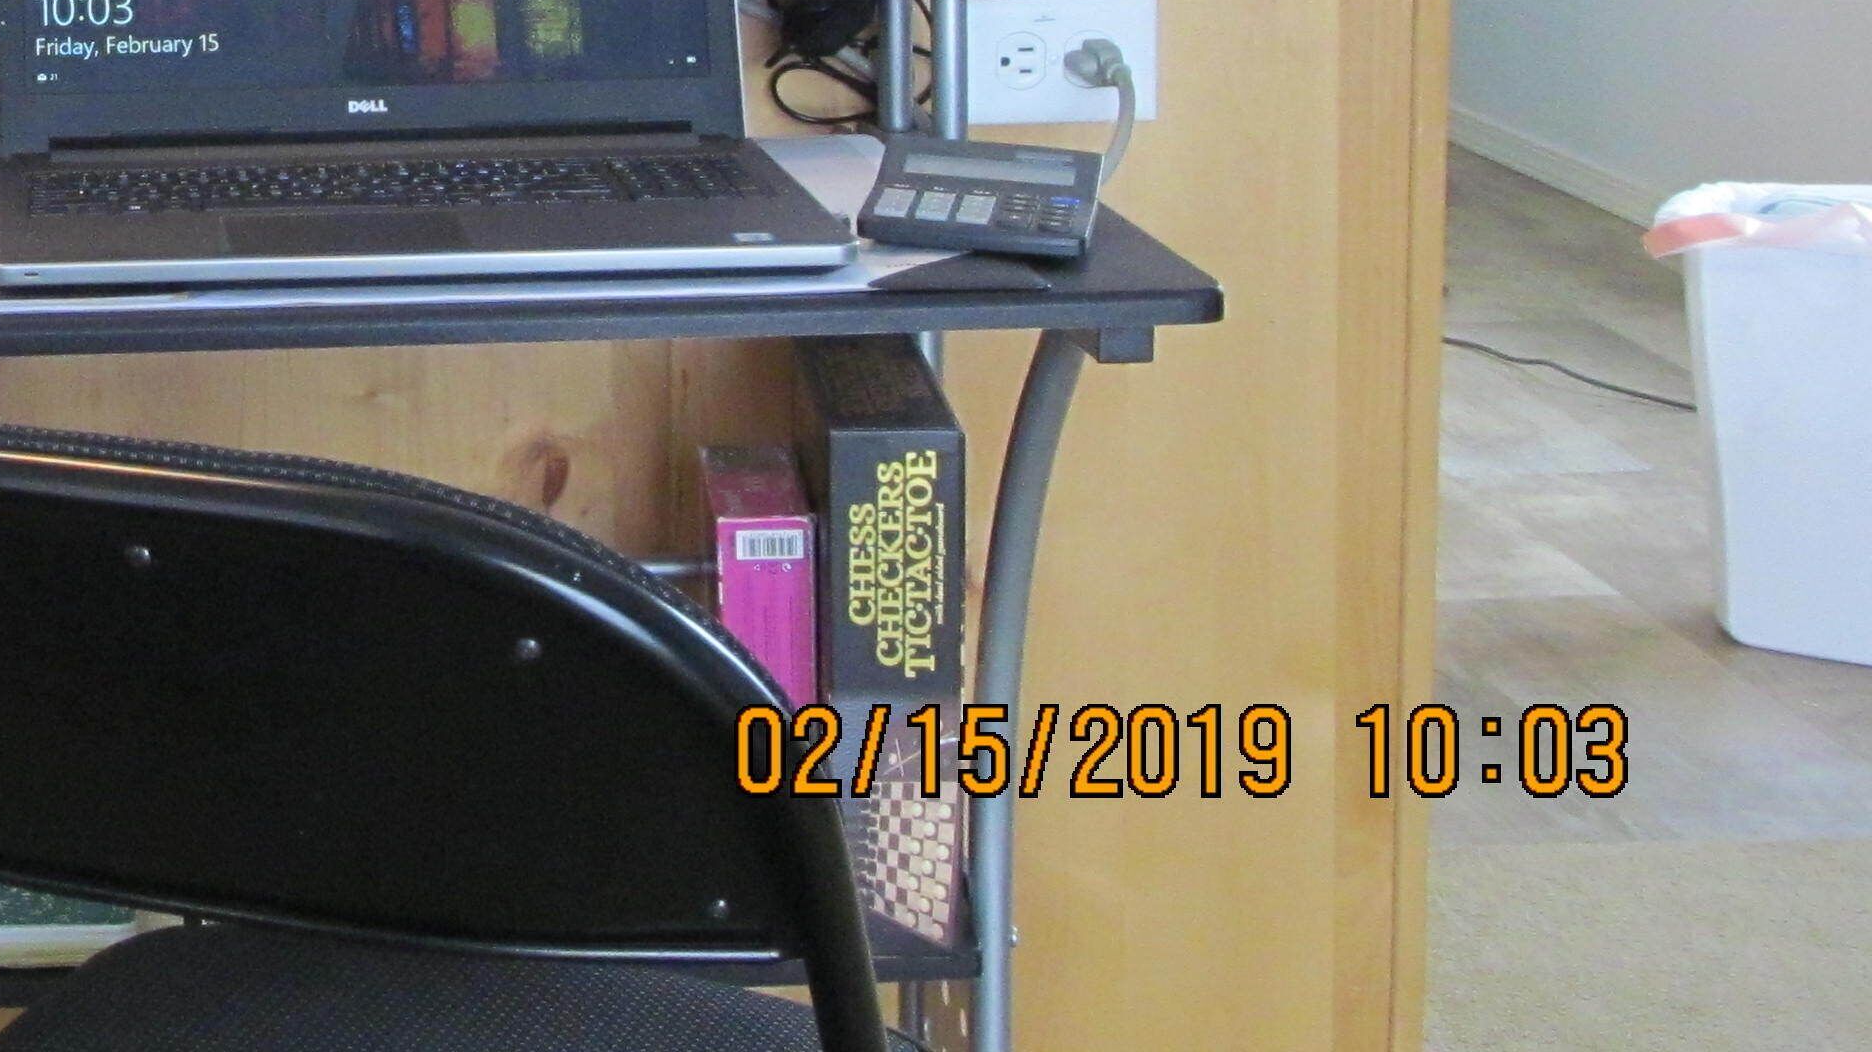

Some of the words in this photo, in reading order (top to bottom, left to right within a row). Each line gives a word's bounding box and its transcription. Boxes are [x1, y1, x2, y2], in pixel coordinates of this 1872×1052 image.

[35, 36, 99, 60] Friday,
[105, 35, 193, 58] February
[198, 33, 220, 52] 15
[348, 99, 388, 113] DELL
[935, 503, 946, 555] gameboard
[848, 503, 877, 626] CHESS
[876, 461, 905, 667] CHECKERS
[936, 555, 944, 580] sided
